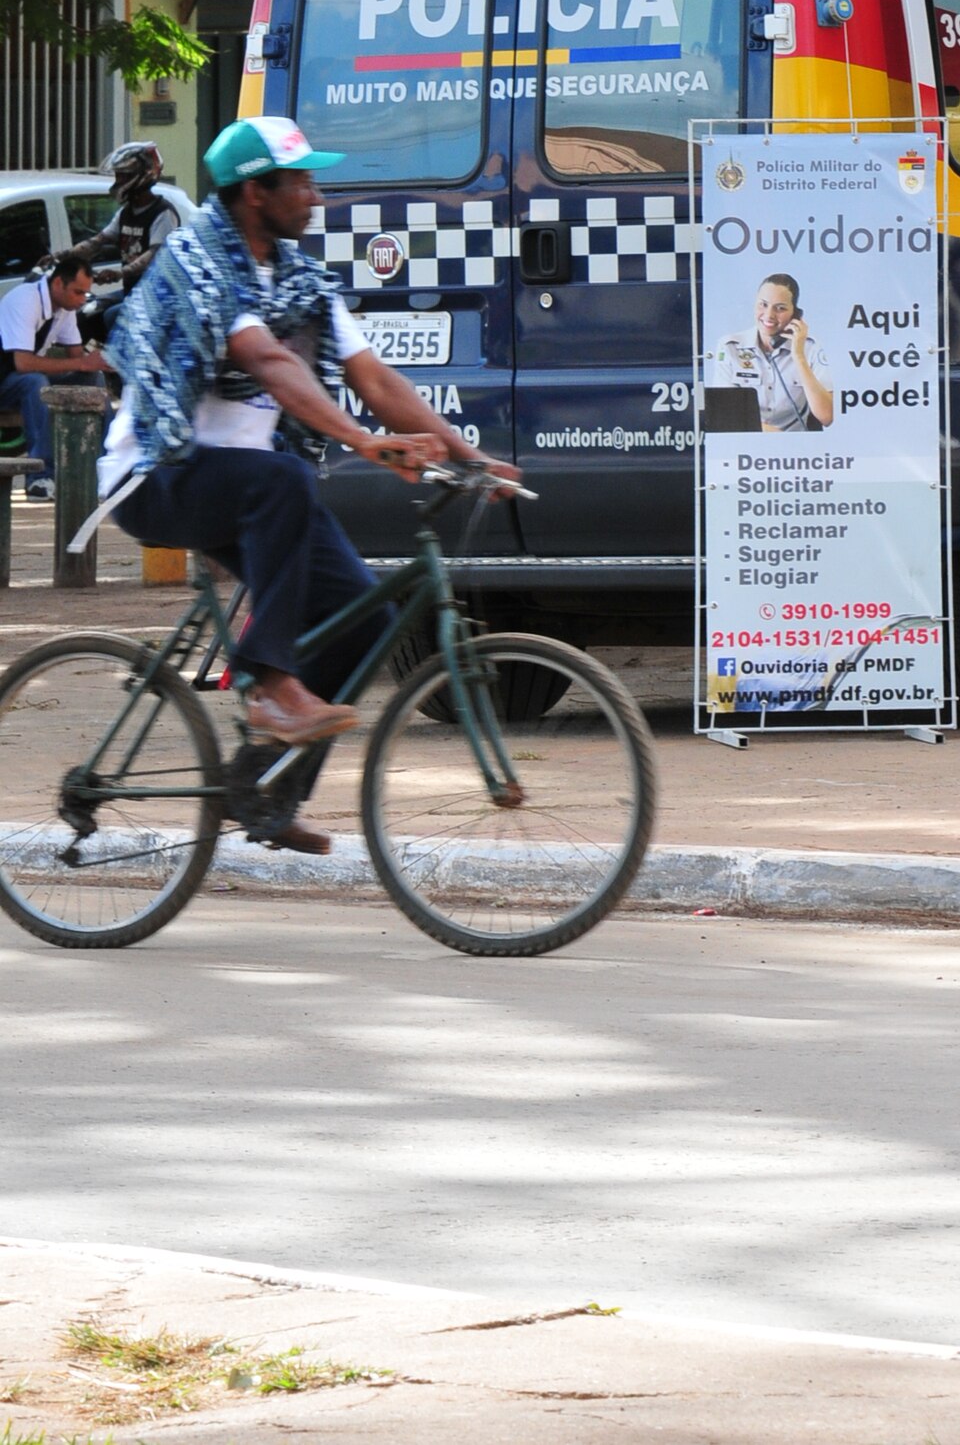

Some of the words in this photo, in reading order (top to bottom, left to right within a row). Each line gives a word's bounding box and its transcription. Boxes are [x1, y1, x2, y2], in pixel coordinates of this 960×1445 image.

[326, 81, 408, 105] MUITO
[416, 78, 480, 102] MAIS
[489, 76, 538, 101] QUE
[545, 70, 710, 98] SEGURANÇA
[756, 159, 804, 173] Polícia
[810, 159, 859, 173] Militar
[864, 158, 882, 172] do
[762, 178, 816, 191] Distrito
[821, 178, 878, 191] Federal
[711, 214, 933, 255] Ouvidoria
[374, 247, 396, 268] FIAT
[847, 303, 921, 336] Aqui
[848, 342, 921, 368] você
[840, 380, 930, 414] pode!
[737, 453, 855, 471] Denunciar
[737, 476, 834, 494] Solicitar
[737, 498, 887, 517] Policiamento
[737, 521, 849, 539] Reclamar
[737, 544, 822, 566] Sugerir
[738, 567, 819, 589] Elogiar
[781, 602, 892, 621] 3910-1999
[711, 628, 940, 649] 2104-1531/2104-1451
[740, 659, 828, 675] Ouvidoria
[835, 658, 858, 673] da
[863, 657, 916, 673] PMDF
